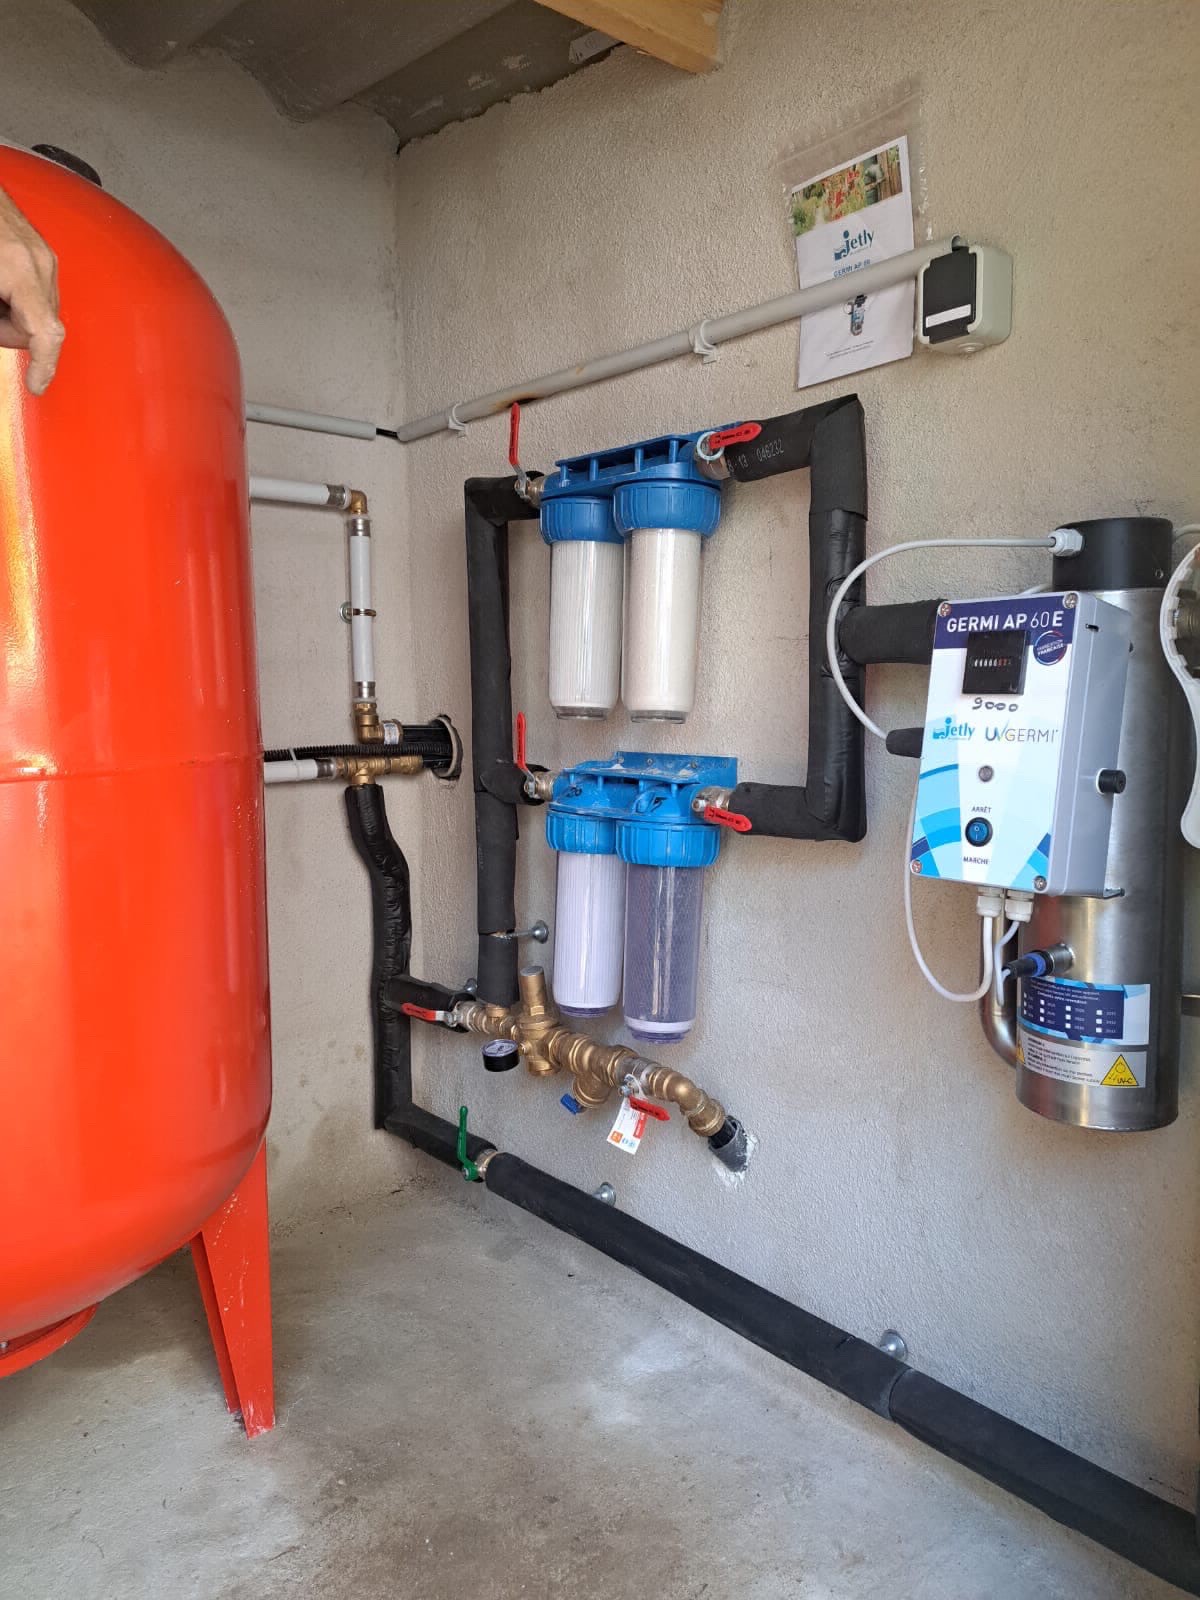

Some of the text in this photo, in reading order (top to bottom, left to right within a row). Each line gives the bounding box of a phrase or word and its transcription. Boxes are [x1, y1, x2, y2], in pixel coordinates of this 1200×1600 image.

[842, 229, 875, 257] jetly
[756, 440, 785, 462] 046232
[947, 614, 999, 632] GERMI
[1003, 613, 1028, 630] AP
[972, 697, 1018, 713] 9000
[942, 717, 976, 740] jetly
[971, 805, 993, 814] ARRÊT
[963, 856, 990, 865] MARCHE
